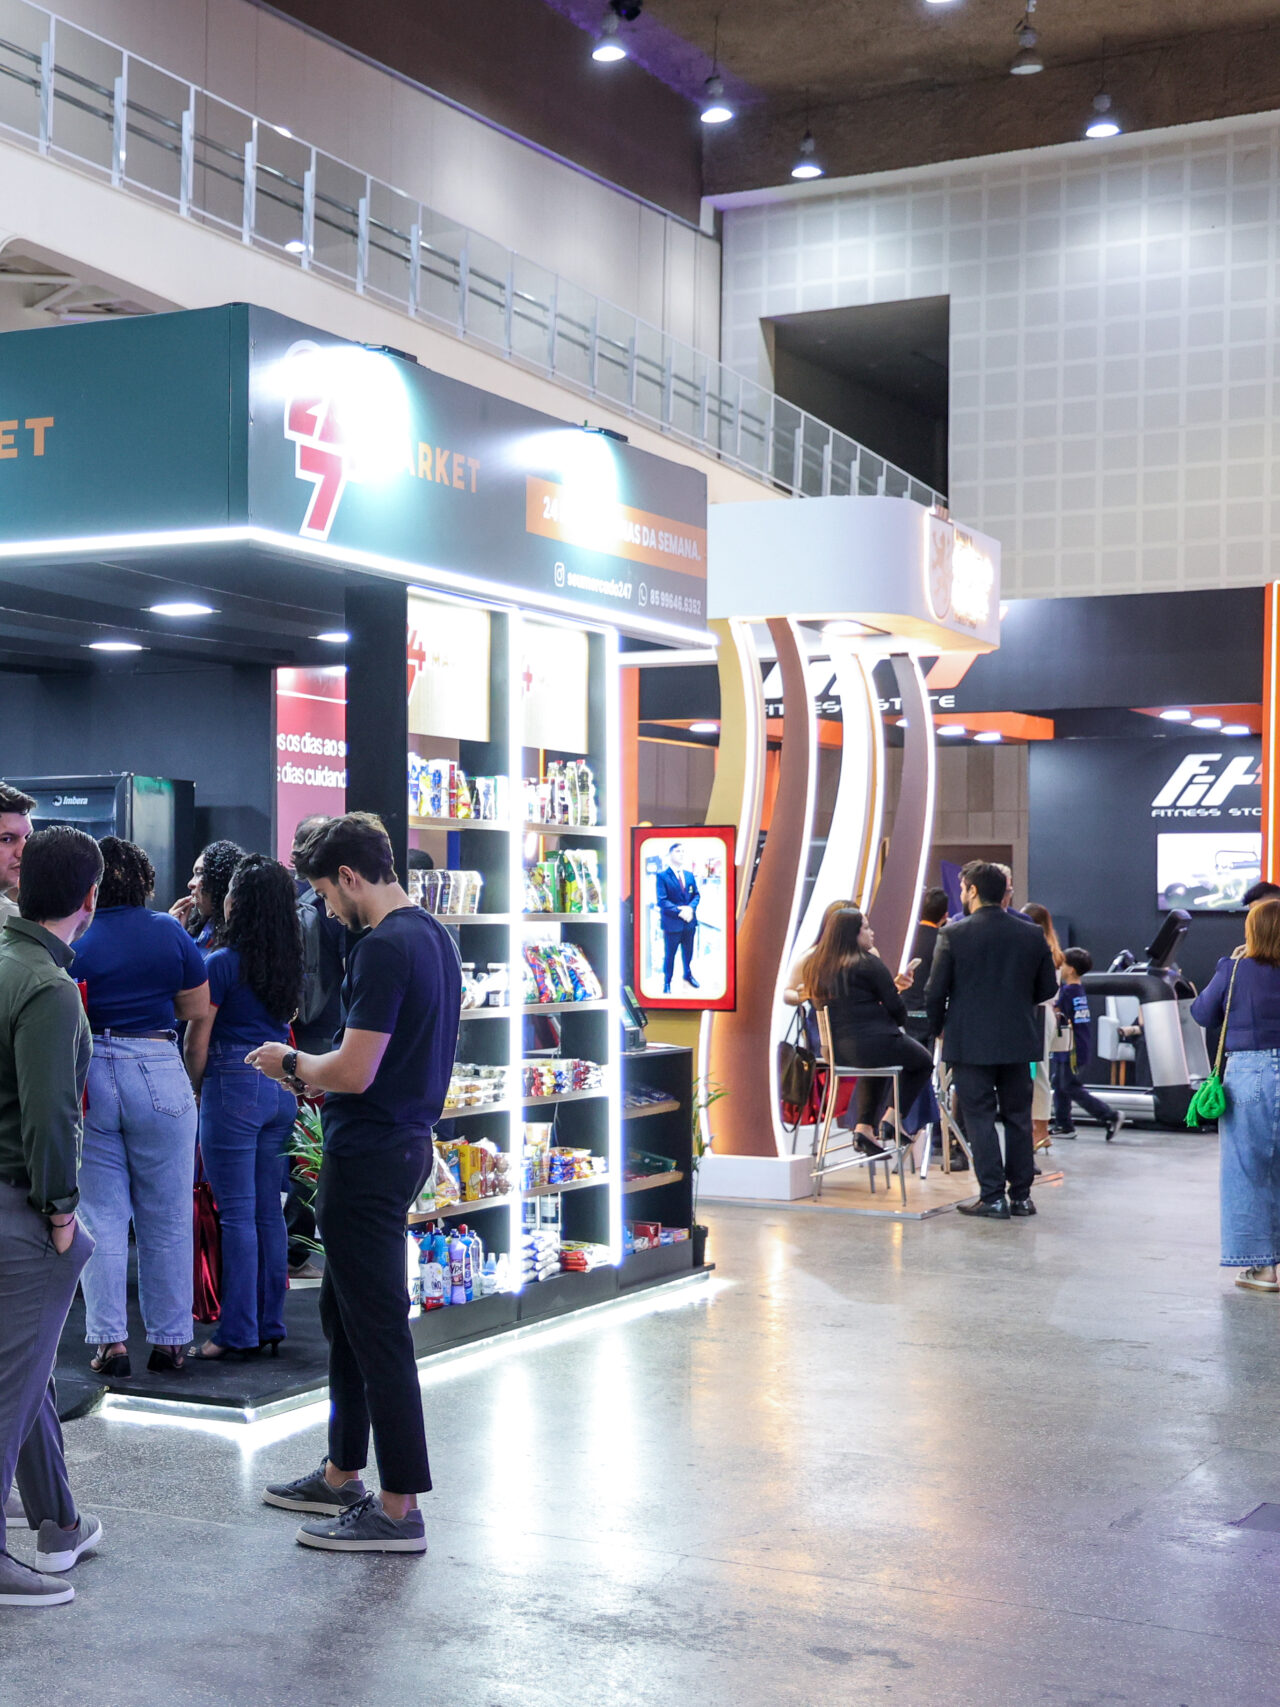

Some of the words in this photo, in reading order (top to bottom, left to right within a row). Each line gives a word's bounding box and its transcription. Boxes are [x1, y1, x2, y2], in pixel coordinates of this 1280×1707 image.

[642, 525, 657, 550] DA
[658, 530, 702, 561] SEMANA.
[650, 588, 660, 606] 85
[305, 764, 347, 789] cuidand
[1151, 808, 1222, 818] FITNESS
